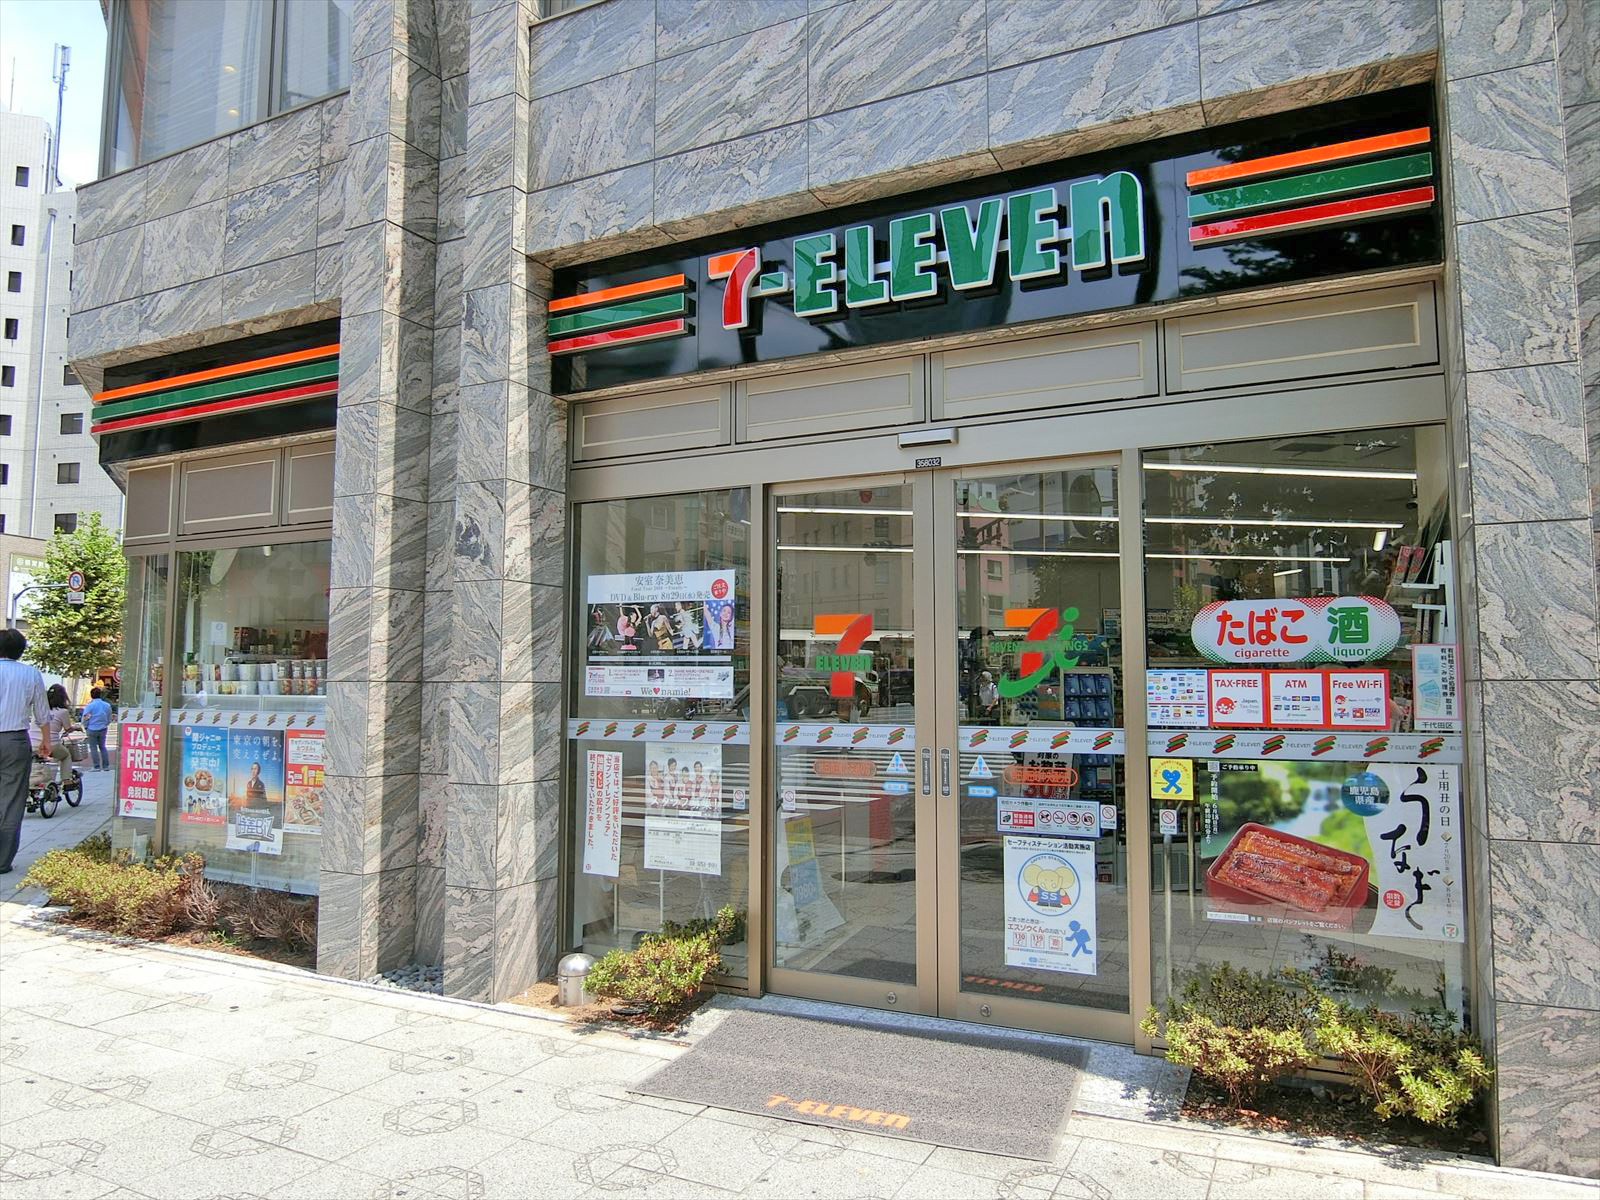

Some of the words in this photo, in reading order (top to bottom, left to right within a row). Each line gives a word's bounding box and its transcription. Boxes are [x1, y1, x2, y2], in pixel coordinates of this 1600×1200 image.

[917, 457, 941, 468] 358032
[1216, 608, 1309, 646] たばこ
[1327, 606, 1370, 645] 酒
[1234, 648, 1290, 660] cigarette
[1333, 647, 1371, 658] liquor
[1215, 679, 1259, 688] TAX-FREE
[1284, 680, 1308, 688] ATM
[1332, 680, 1354, 688] Free
[1356, 679, 1382, 688] Wi-Fi
[640, 687, 653, 696] We
[1421, 721, 1453, 729] 千代田区
[127, 726, 160, 748] TAX-
[126, 749, 159, 770] FREE
[132, 770, 153, 783] SHOP
[1350, 786, 1380, 797] 鹿児島
[1355, 796, 1375, 805] 県産
[1438, 769, 1451, 828] 土用丑の日
[1040, 890, 1058, 901] SS
